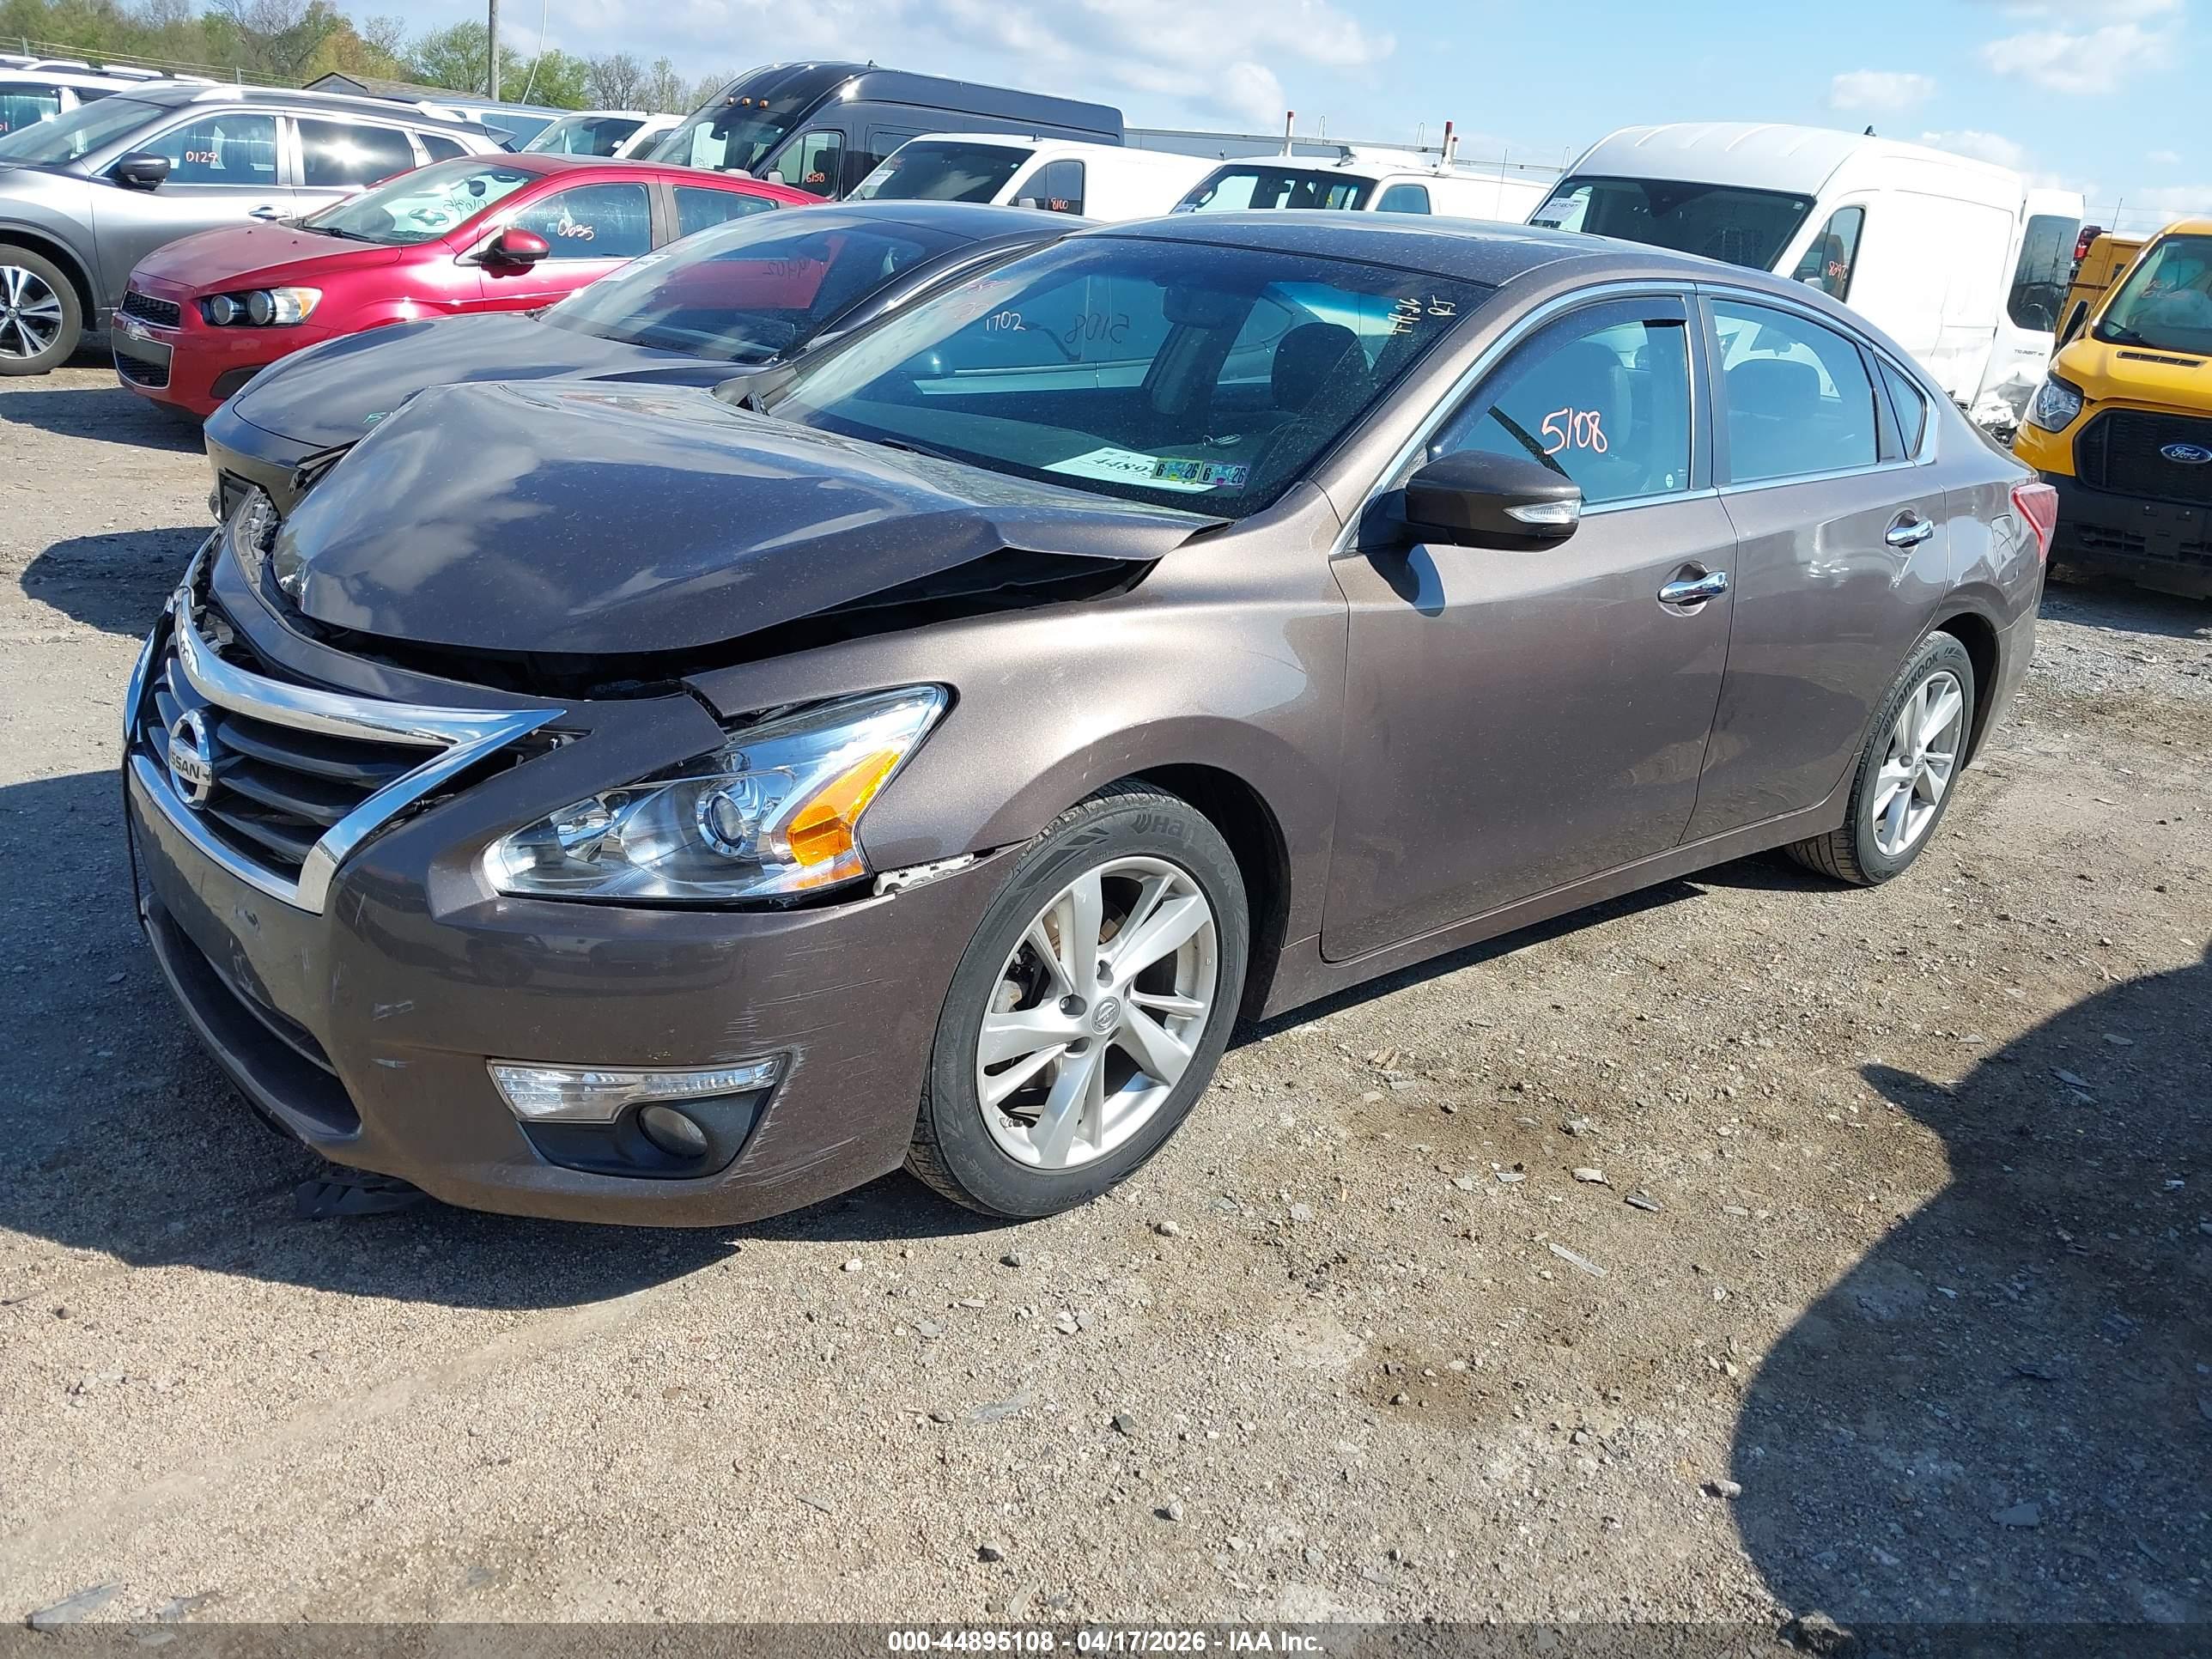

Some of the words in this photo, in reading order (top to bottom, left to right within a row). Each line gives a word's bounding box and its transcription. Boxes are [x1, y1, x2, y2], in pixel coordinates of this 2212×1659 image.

[185, 150, 218, 163] 0129
[557, 218, 595, 240] 0635
[986, 311, 1026, 331] 1702
[1541, 407, 1608, 455] 5108
[2171, 446, 2201, 460] Ford
[1184, 463, 1200, 479] 26
[1231, 467, 1248, 483] 26
